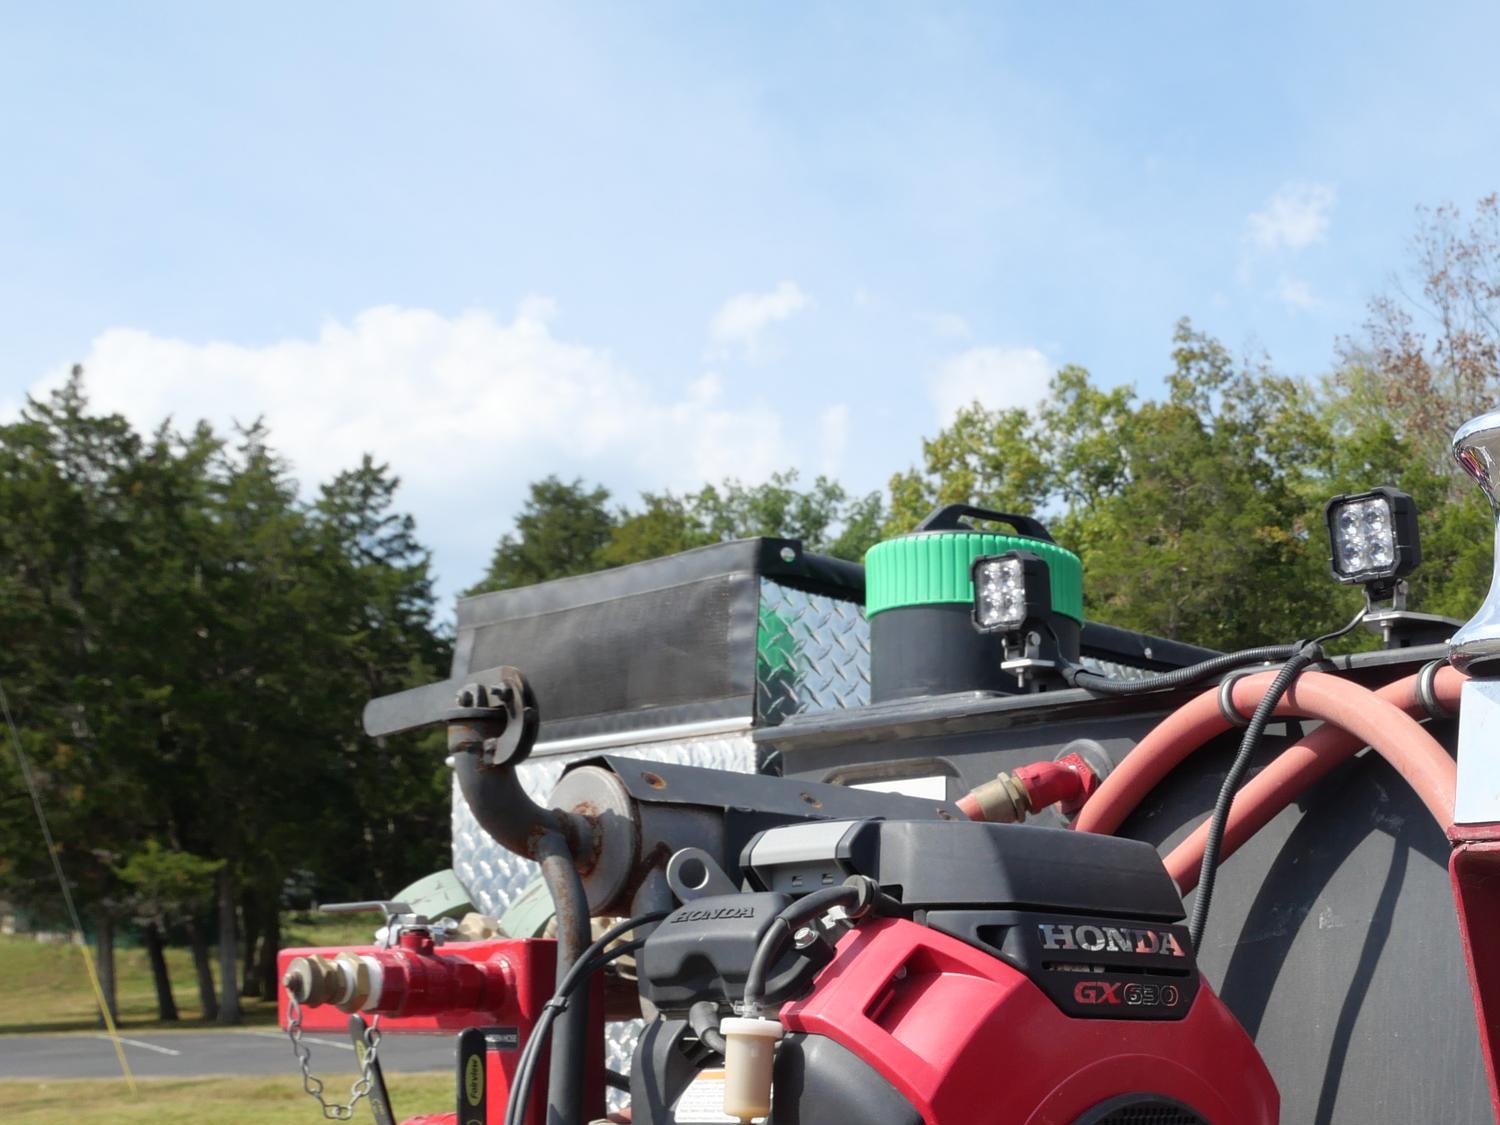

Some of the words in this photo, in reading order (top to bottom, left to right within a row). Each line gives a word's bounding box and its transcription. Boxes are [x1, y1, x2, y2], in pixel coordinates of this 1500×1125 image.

[671, 907, 755, 924] HONDA
[1038, 924, 1185, 957] HONDA
[1073, 981, 1121, 1004] GX
[1123, 983, 1179, 1007] 630
